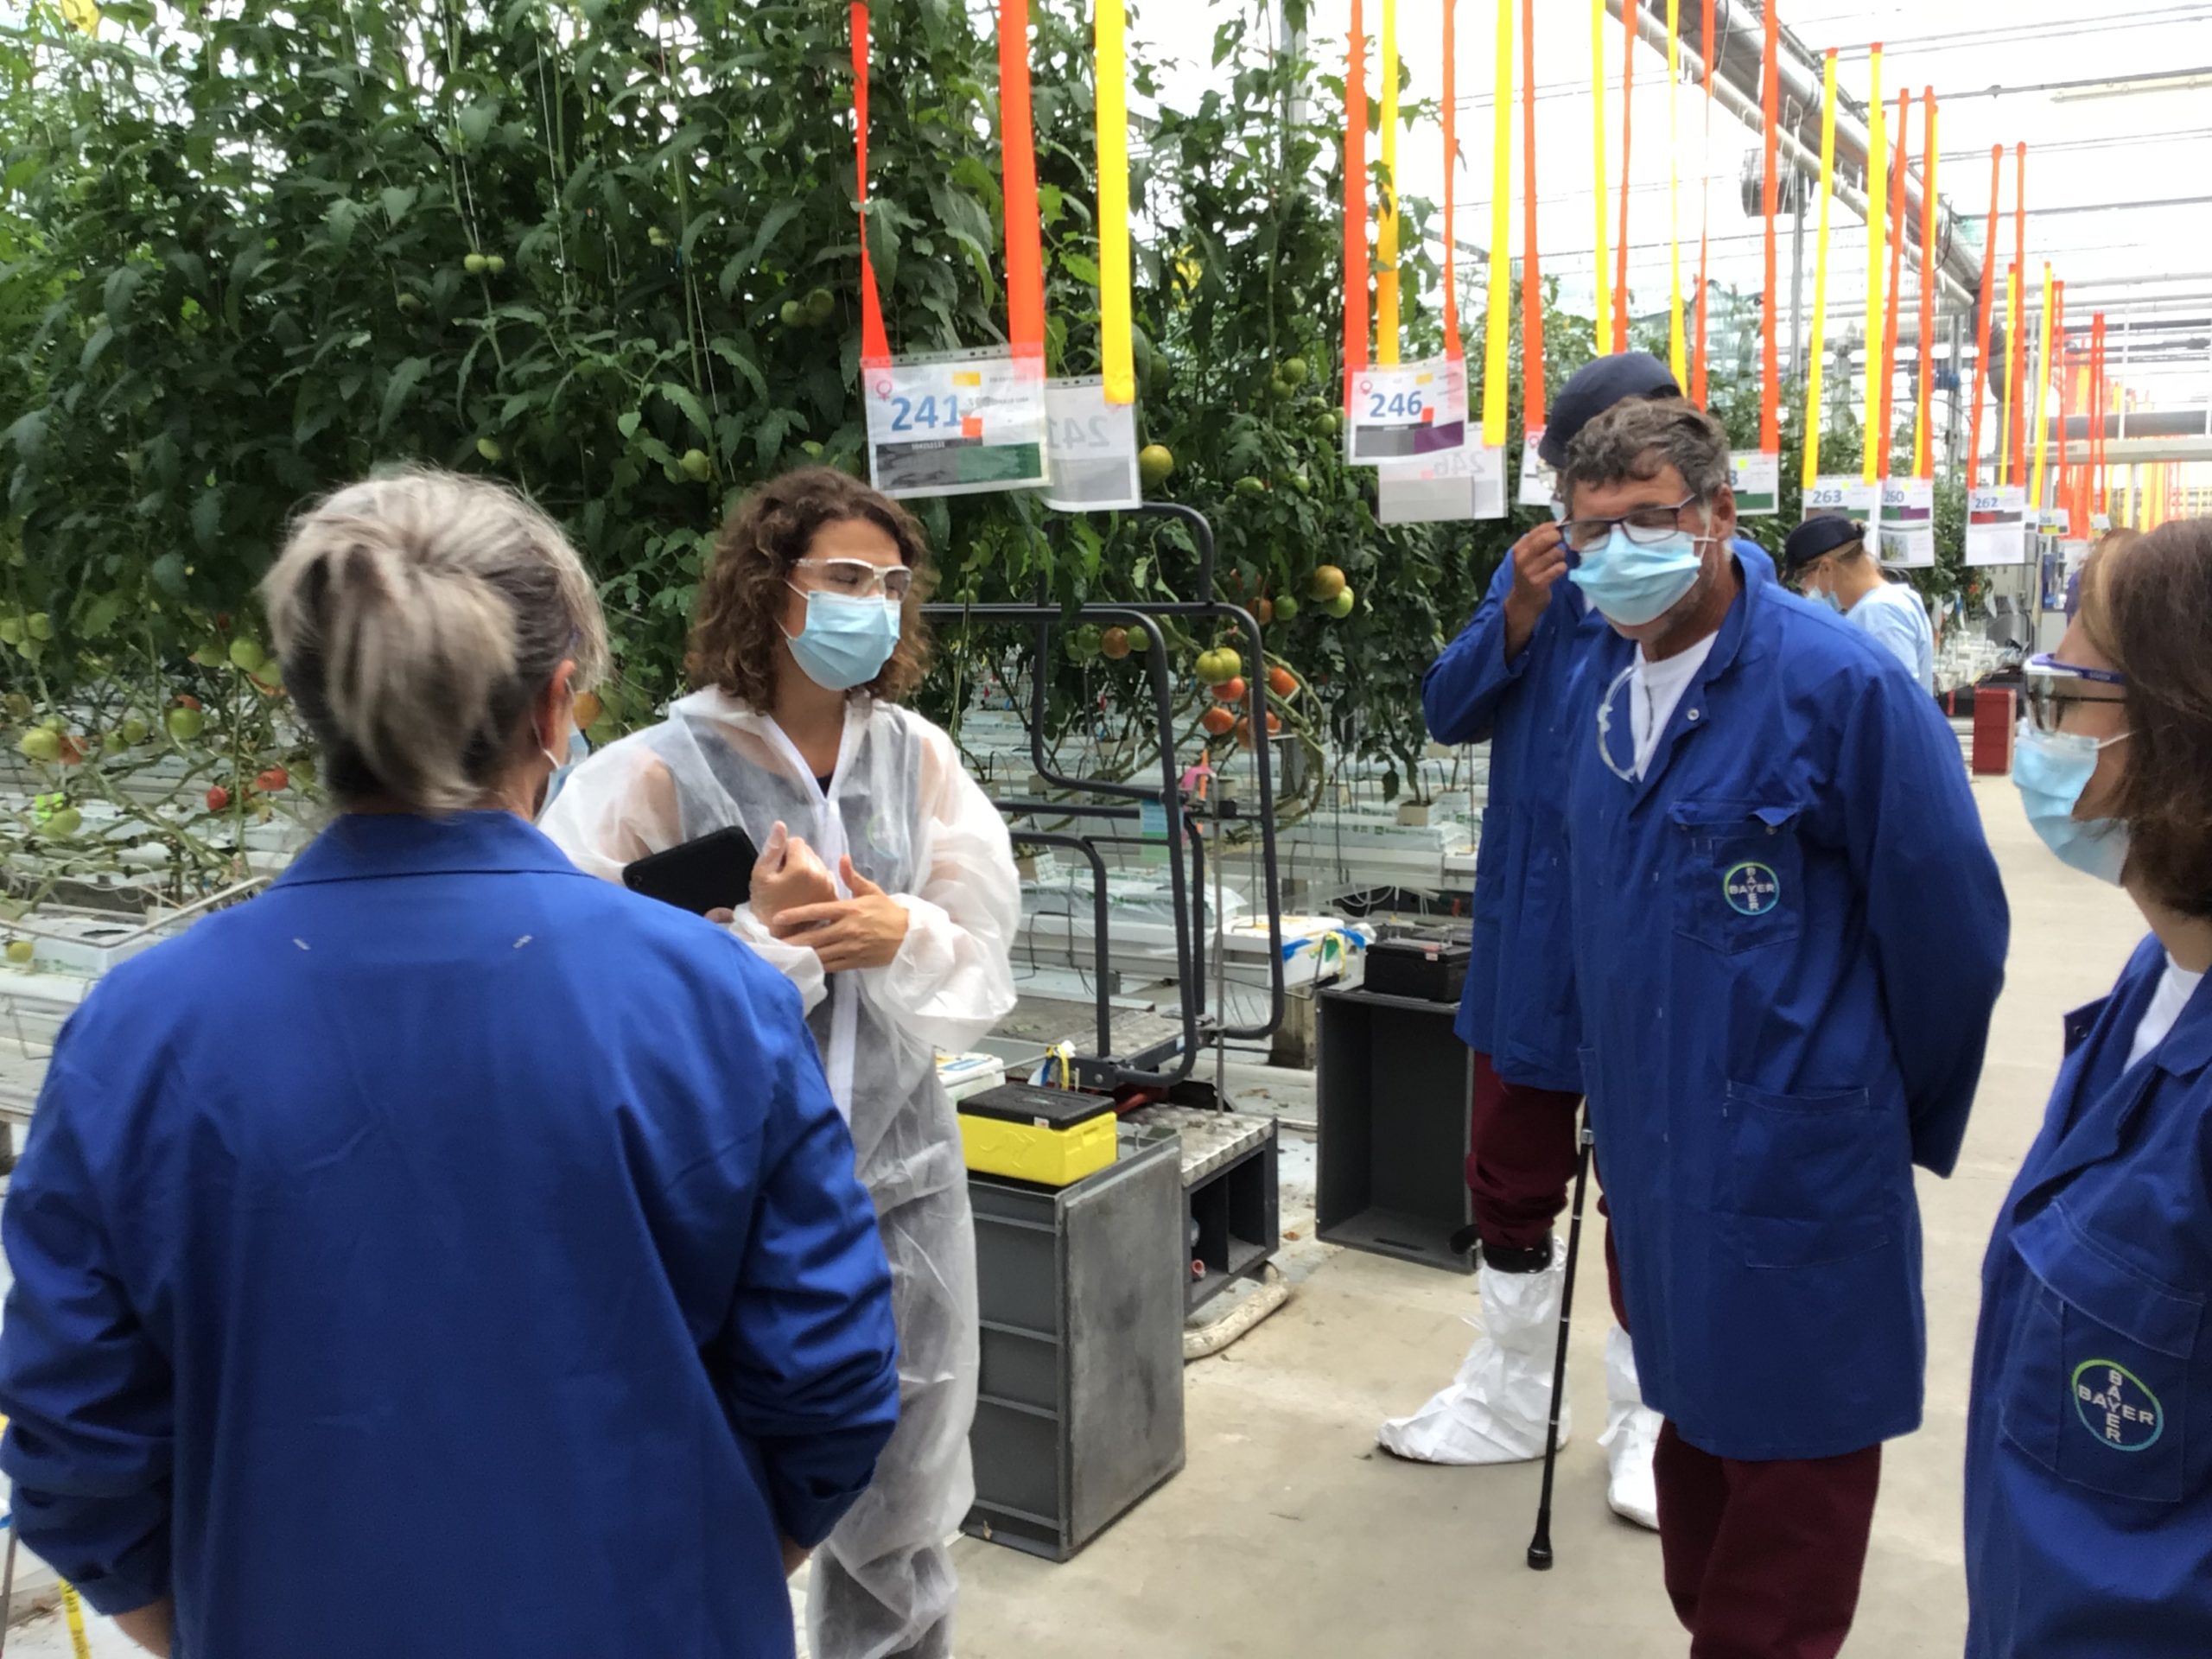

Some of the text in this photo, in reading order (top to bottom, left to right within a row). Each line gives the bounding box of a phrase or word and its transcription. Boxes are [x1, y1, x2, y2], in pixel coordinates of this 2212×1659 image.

[891, 394, 960, 431] 241
[1370, 391, 1423, 417] 246
[1813, 490, 1842, 503] 263
[1975, 497, 1998, 508] 262
[1729, 883, 1775, 894] BAYER
[2078, 1383, 2155, 1426] BAYER
[2106, 1370, 2123, 1444] BAYER
